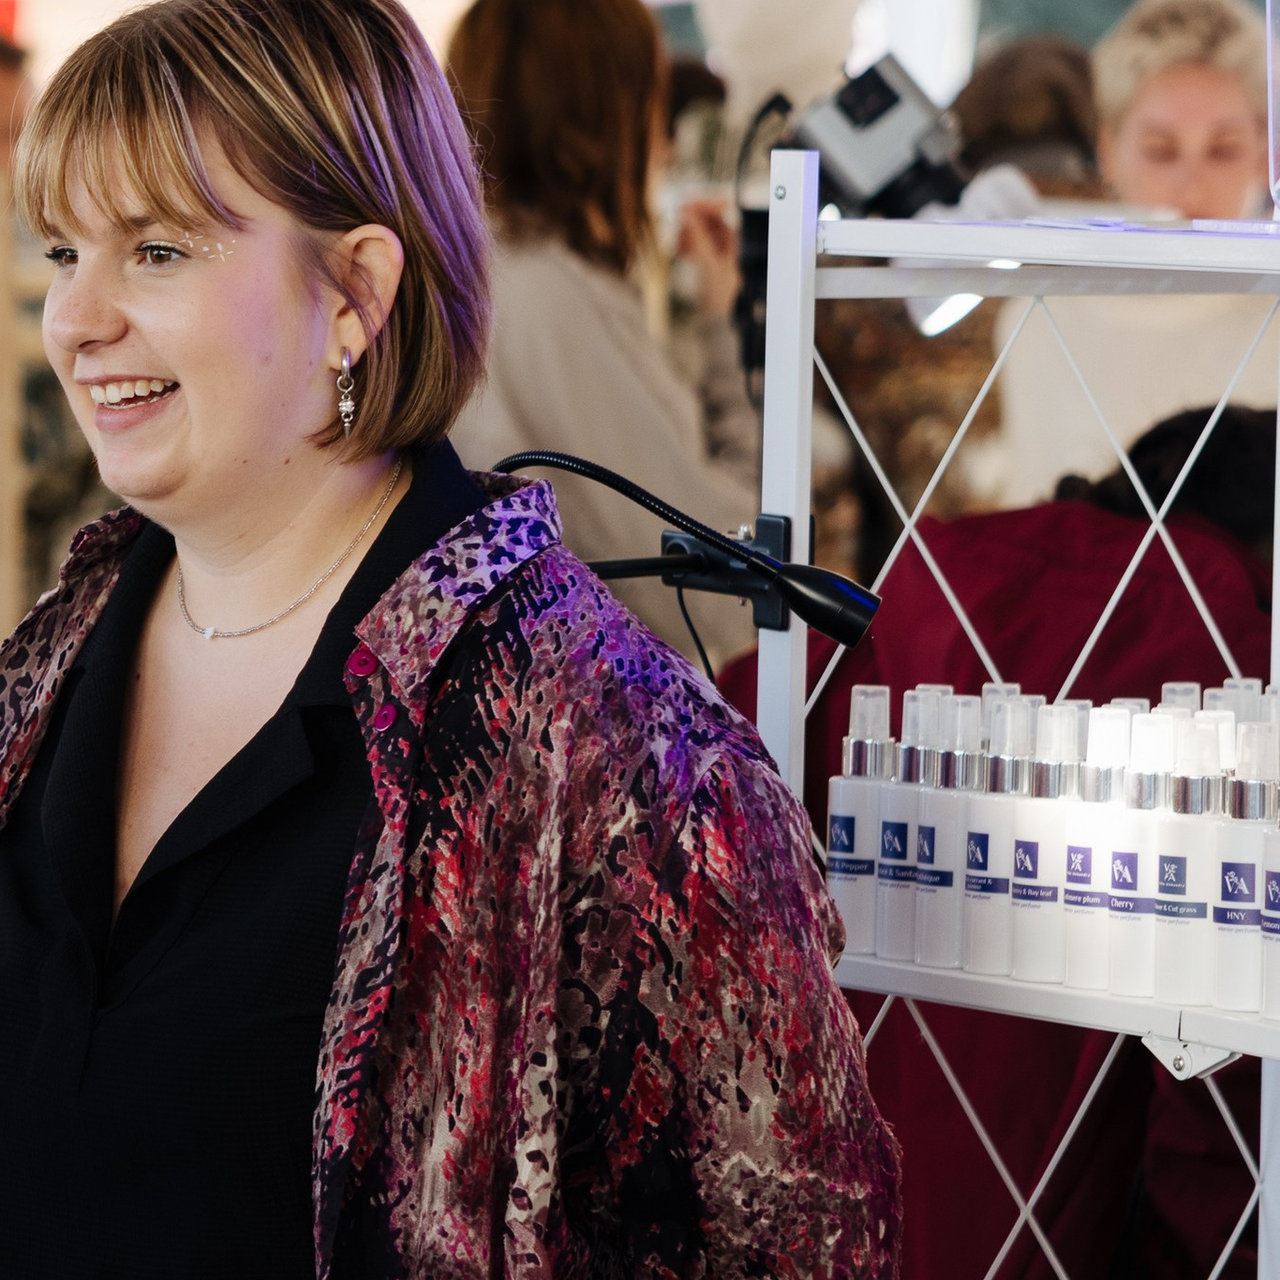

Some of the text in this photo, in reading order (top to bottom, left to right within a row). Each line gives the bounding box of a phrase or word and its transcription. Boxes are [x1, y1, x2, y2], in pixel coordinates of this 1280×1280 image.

[841, 861, 869, 872] Pepper
[1039, 890, 1053, 899] leaf
[1082, 895, 1101, 905] plum
[1110, 897, 1135, 910] Cherry
[1167, 904, 1179, 913] Cut
[1179, 905, 1198, 915] grass
[1226, 910, 1247, 921] HNY
[1234, 926, 1260, 935] perfume
